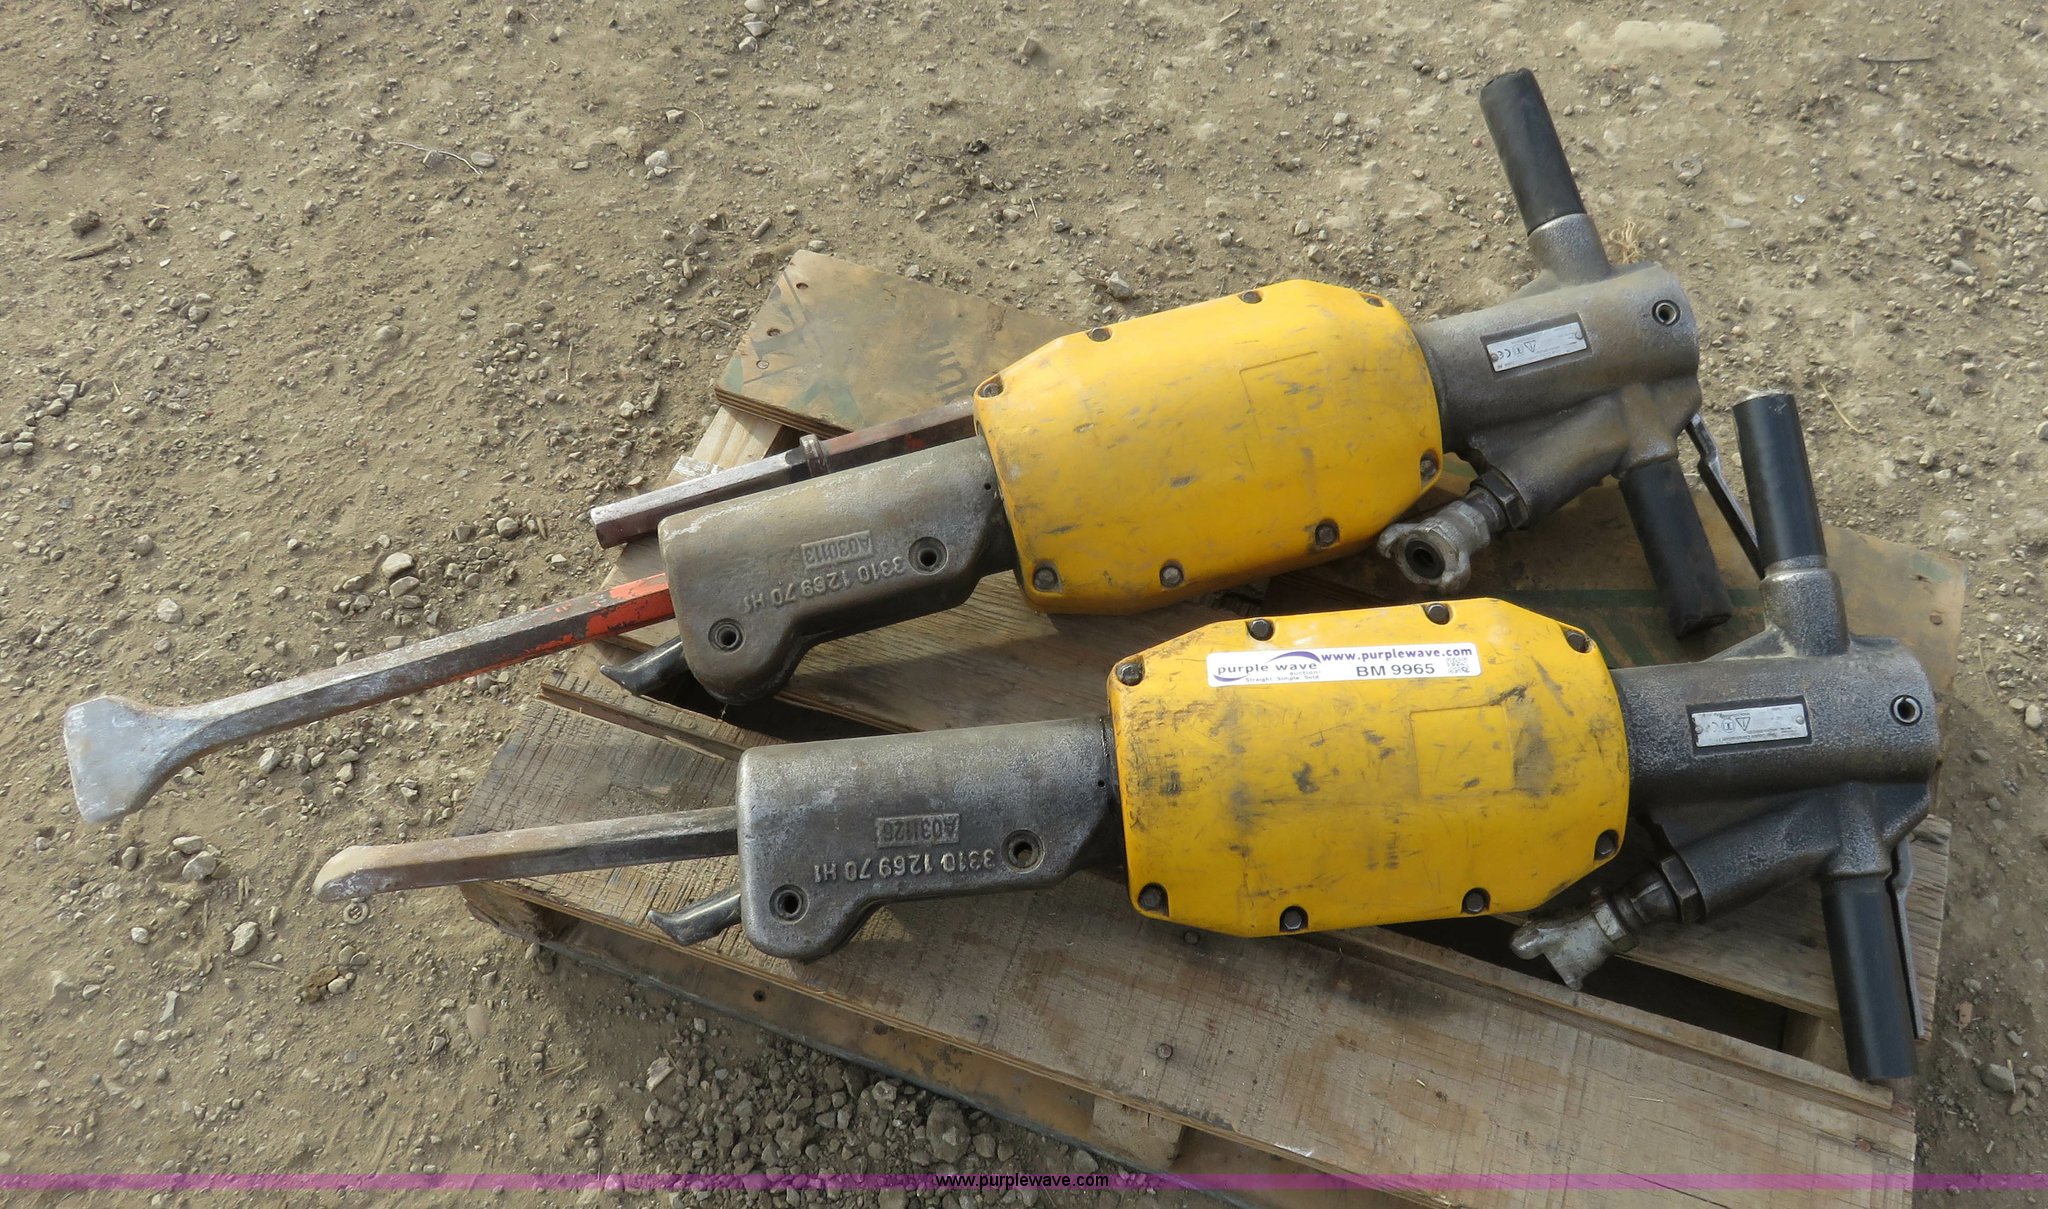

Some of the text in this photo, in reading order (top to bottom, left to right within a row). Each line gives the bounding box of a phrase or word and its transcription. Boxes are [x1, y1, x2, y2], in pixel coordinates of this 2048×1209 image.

[857, 556, 905, 583] 3310
[770, 583, 796, 607] 70
[800, 569, 849, 597] 1269
[1320, 648, 1473, 662] www.purplewave.com
[1217, 662, 1318, 675] purple wave
[1356, 663, 1436, 677] BM 9965
[813, 849, 996, 883] 3310 1269 70 H1
